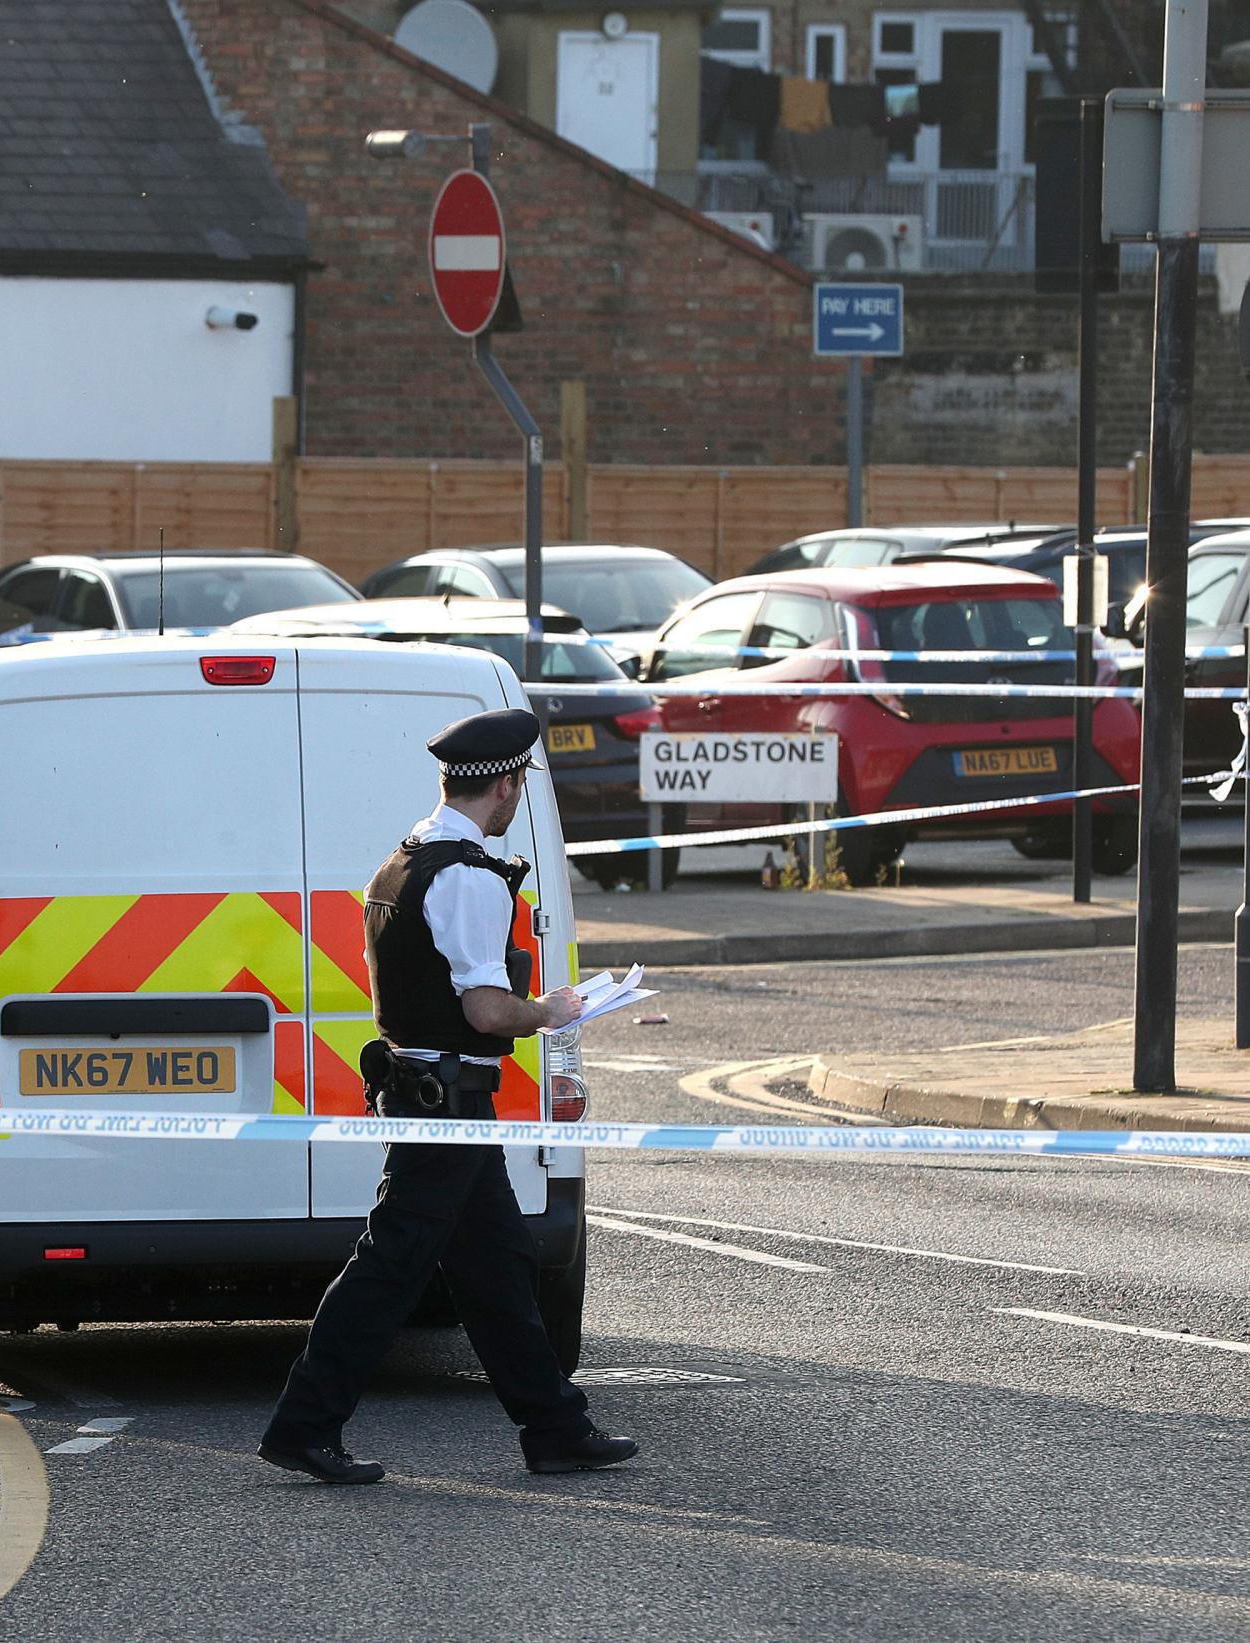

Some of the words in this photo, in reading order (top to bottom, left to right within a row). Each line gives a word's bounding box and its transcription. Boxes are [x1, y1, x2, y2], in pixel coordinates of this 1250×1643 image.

[821, 297, 849, 315] PAY
[853, 298, 895, 316] HERE
[654, 741, 825, 762] GLADSTONE
[1016, 750, 1053, 770] LUE
[655, 770, 712, 790] WAY
[36, 1053, 134, 1088] NK67
